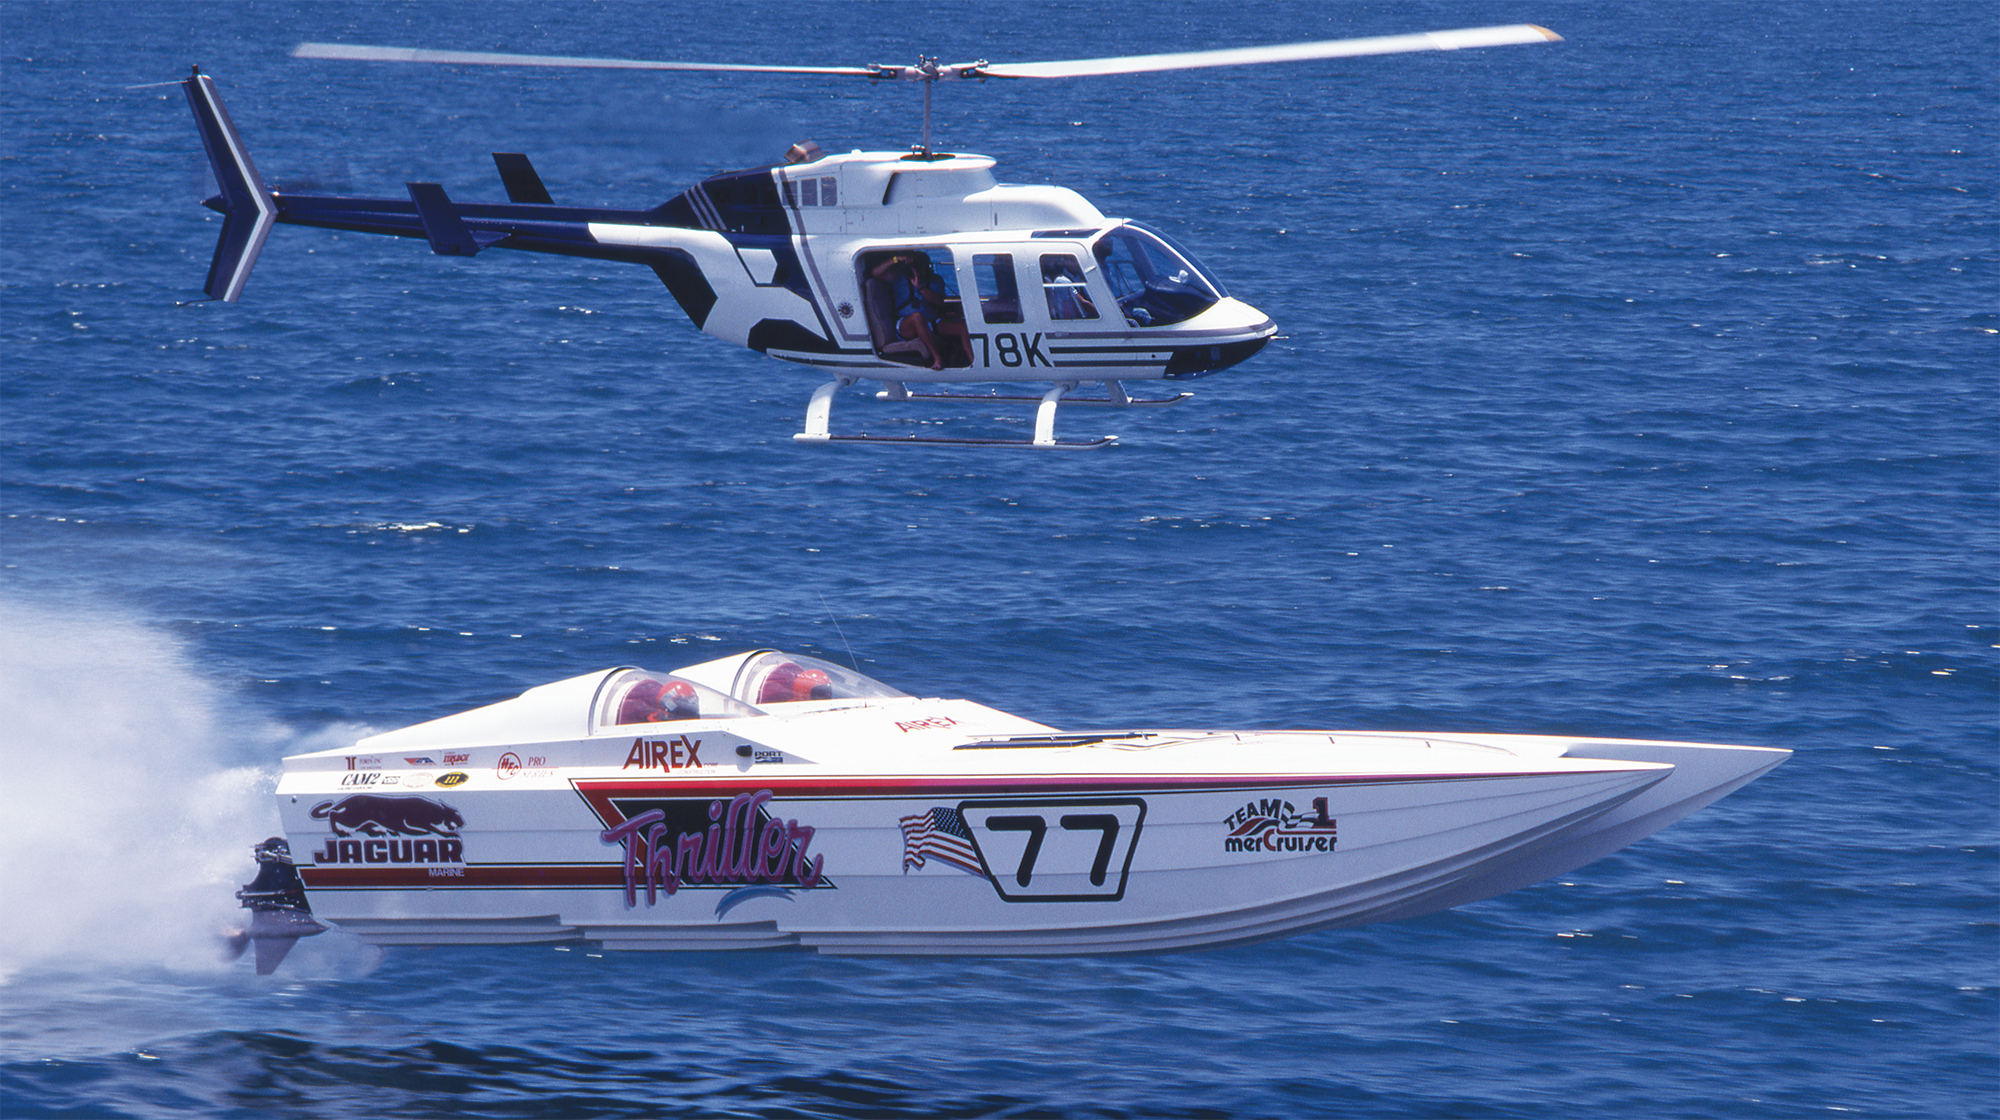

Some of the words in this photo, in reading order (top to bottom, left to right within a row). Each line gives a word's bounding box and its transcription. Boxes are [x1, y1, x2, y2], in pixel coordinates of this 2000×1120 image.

[528, 756, 547, 766] PRO
[623, 736, 702, 773] AIREX
[341, 773, 380, 786] CAM2
[1223, 798, 1282, 831] TEAM
[1312, 797, 1337, 829] 1
[314, 839, 463, 863] JAGUAR
[601, 790, 823, 907] Thriller
[985, 814, 1118, 887] 77
[428, 867, 465, 877] MARINE
